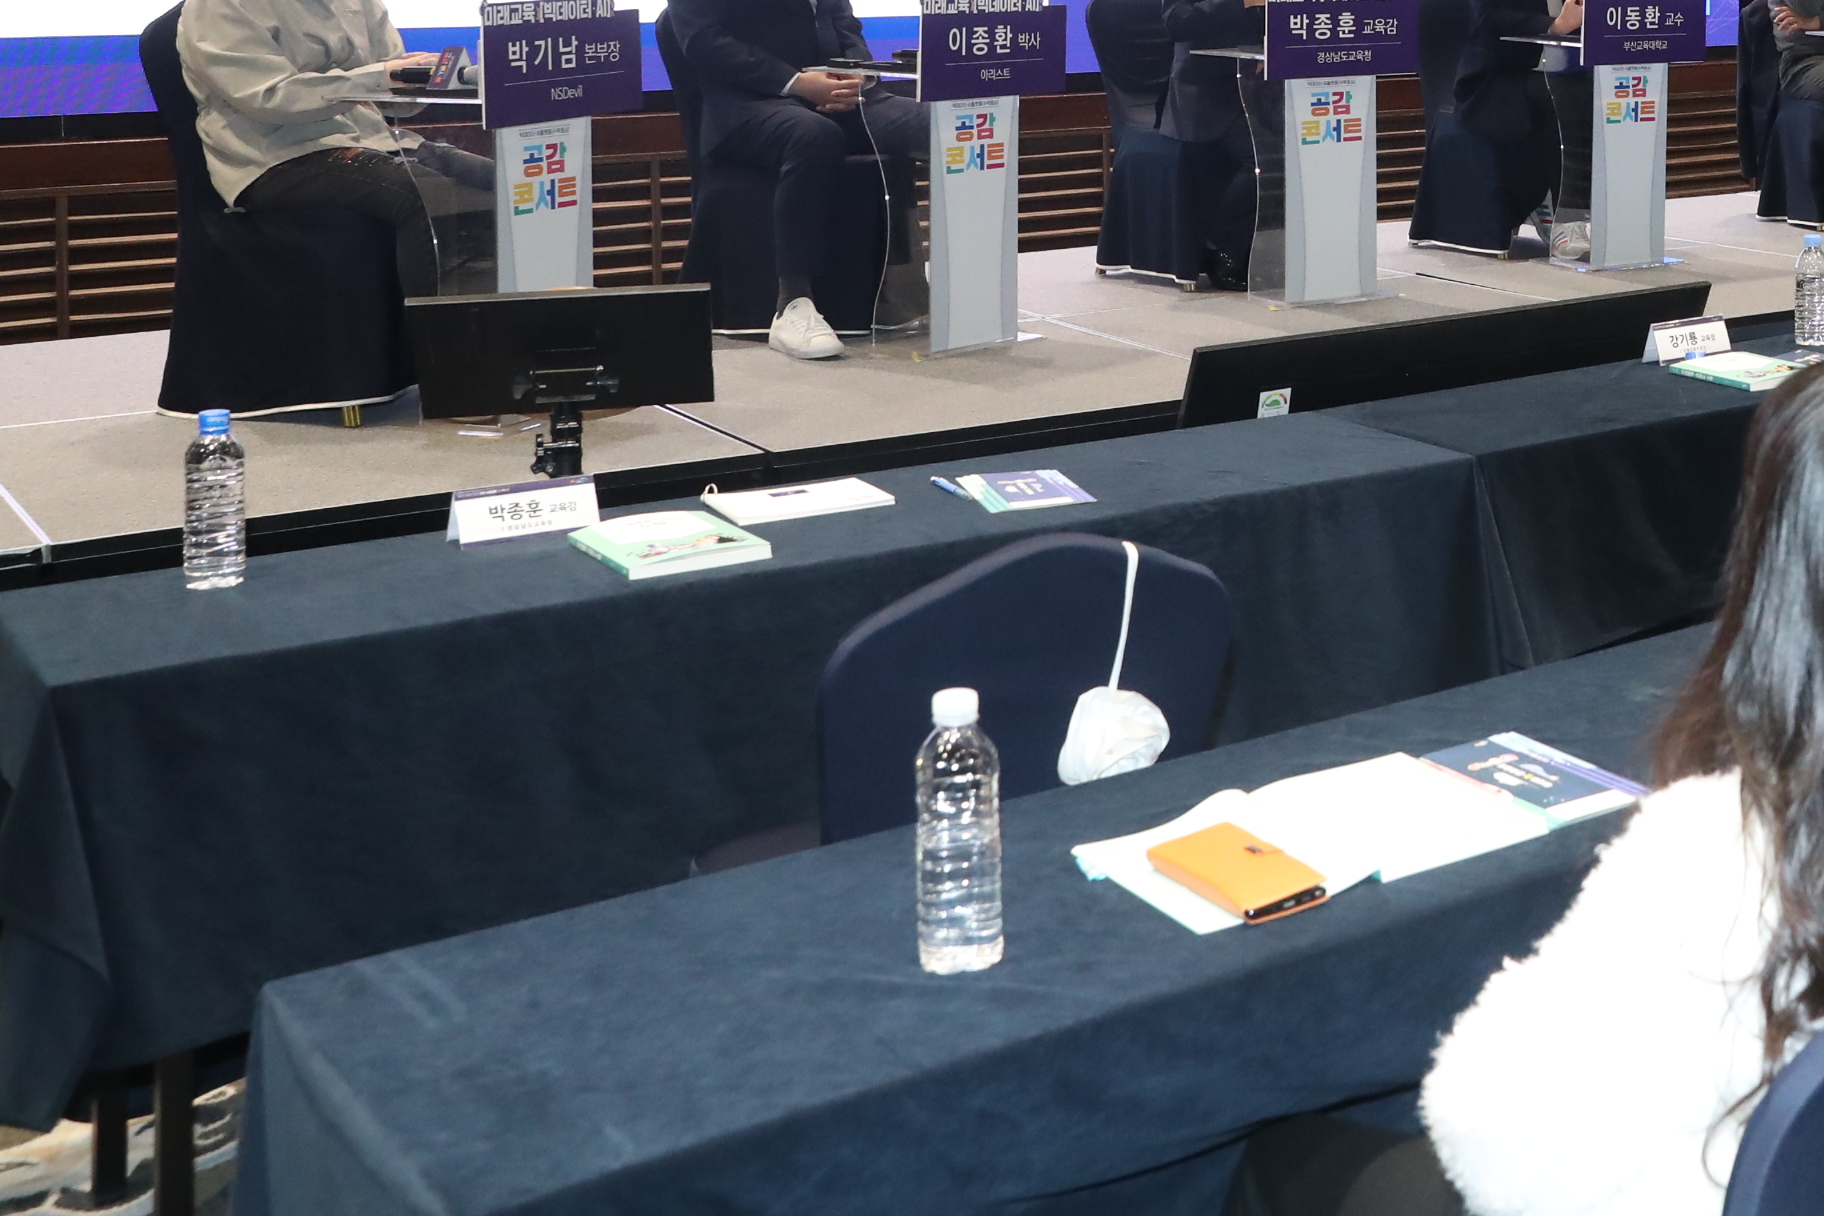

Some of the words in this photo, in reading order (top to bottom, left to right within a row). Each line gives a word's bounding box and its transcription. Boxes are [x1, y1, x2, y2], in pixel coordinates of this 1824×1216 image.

[484, 1, 536, 26] 미래교육
[1664, 12, 1685, 27] 교수
[1362, 18, 1398, 35] 교육감
[584, 41, 620, 64] 본부장
[1018, 32, 1040, 50] 박사
[1317, 50, 1372, 63] 경상남도교육청
[980, 68, 1011, 81] 아리스트
[551, 85, 582, 101] NSDevil
[1614, 76, 1649, 99] 공감
[1310, 91, 1352, 116] 공감
[1606, 101, 1656, 124] 콘서트
[955, 113, 996, 142] 공감
[1301, 118, 1362, 145] 콘서트
[523, 141, 567, 177] 공감
[946, 142, 1005, 174] 콘서트
[513, 176, 577, 216] 콘서트
[488, 499, 543, 522] 박종훈
[549, 501, 577, 513] 교육감
